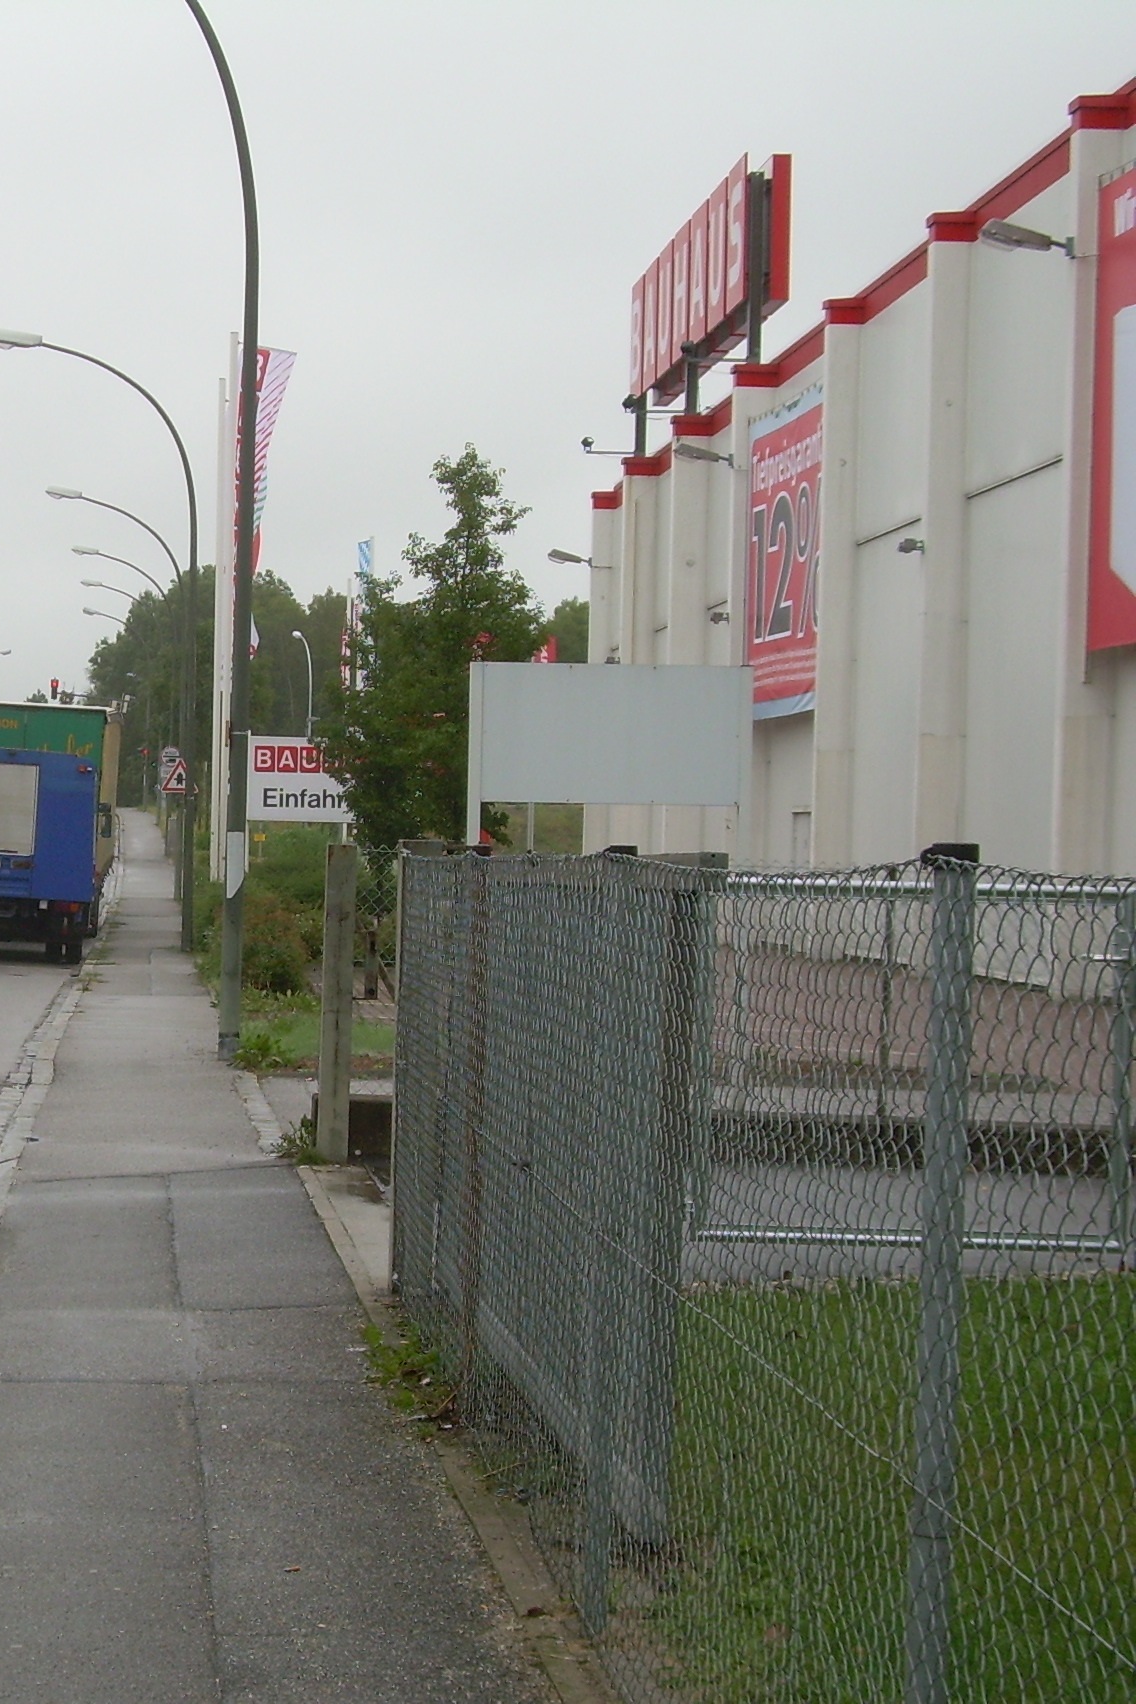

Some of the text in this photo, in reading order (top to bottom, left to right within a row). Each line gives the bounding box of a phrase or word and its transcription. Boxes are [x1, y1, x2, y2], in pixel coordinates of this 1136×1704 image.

[631, 181, 745, 386] BAUHAUS
[752, 422, 822, 497] Tiefpreisgarant
[263, 787, 342, 809] Einfahr
